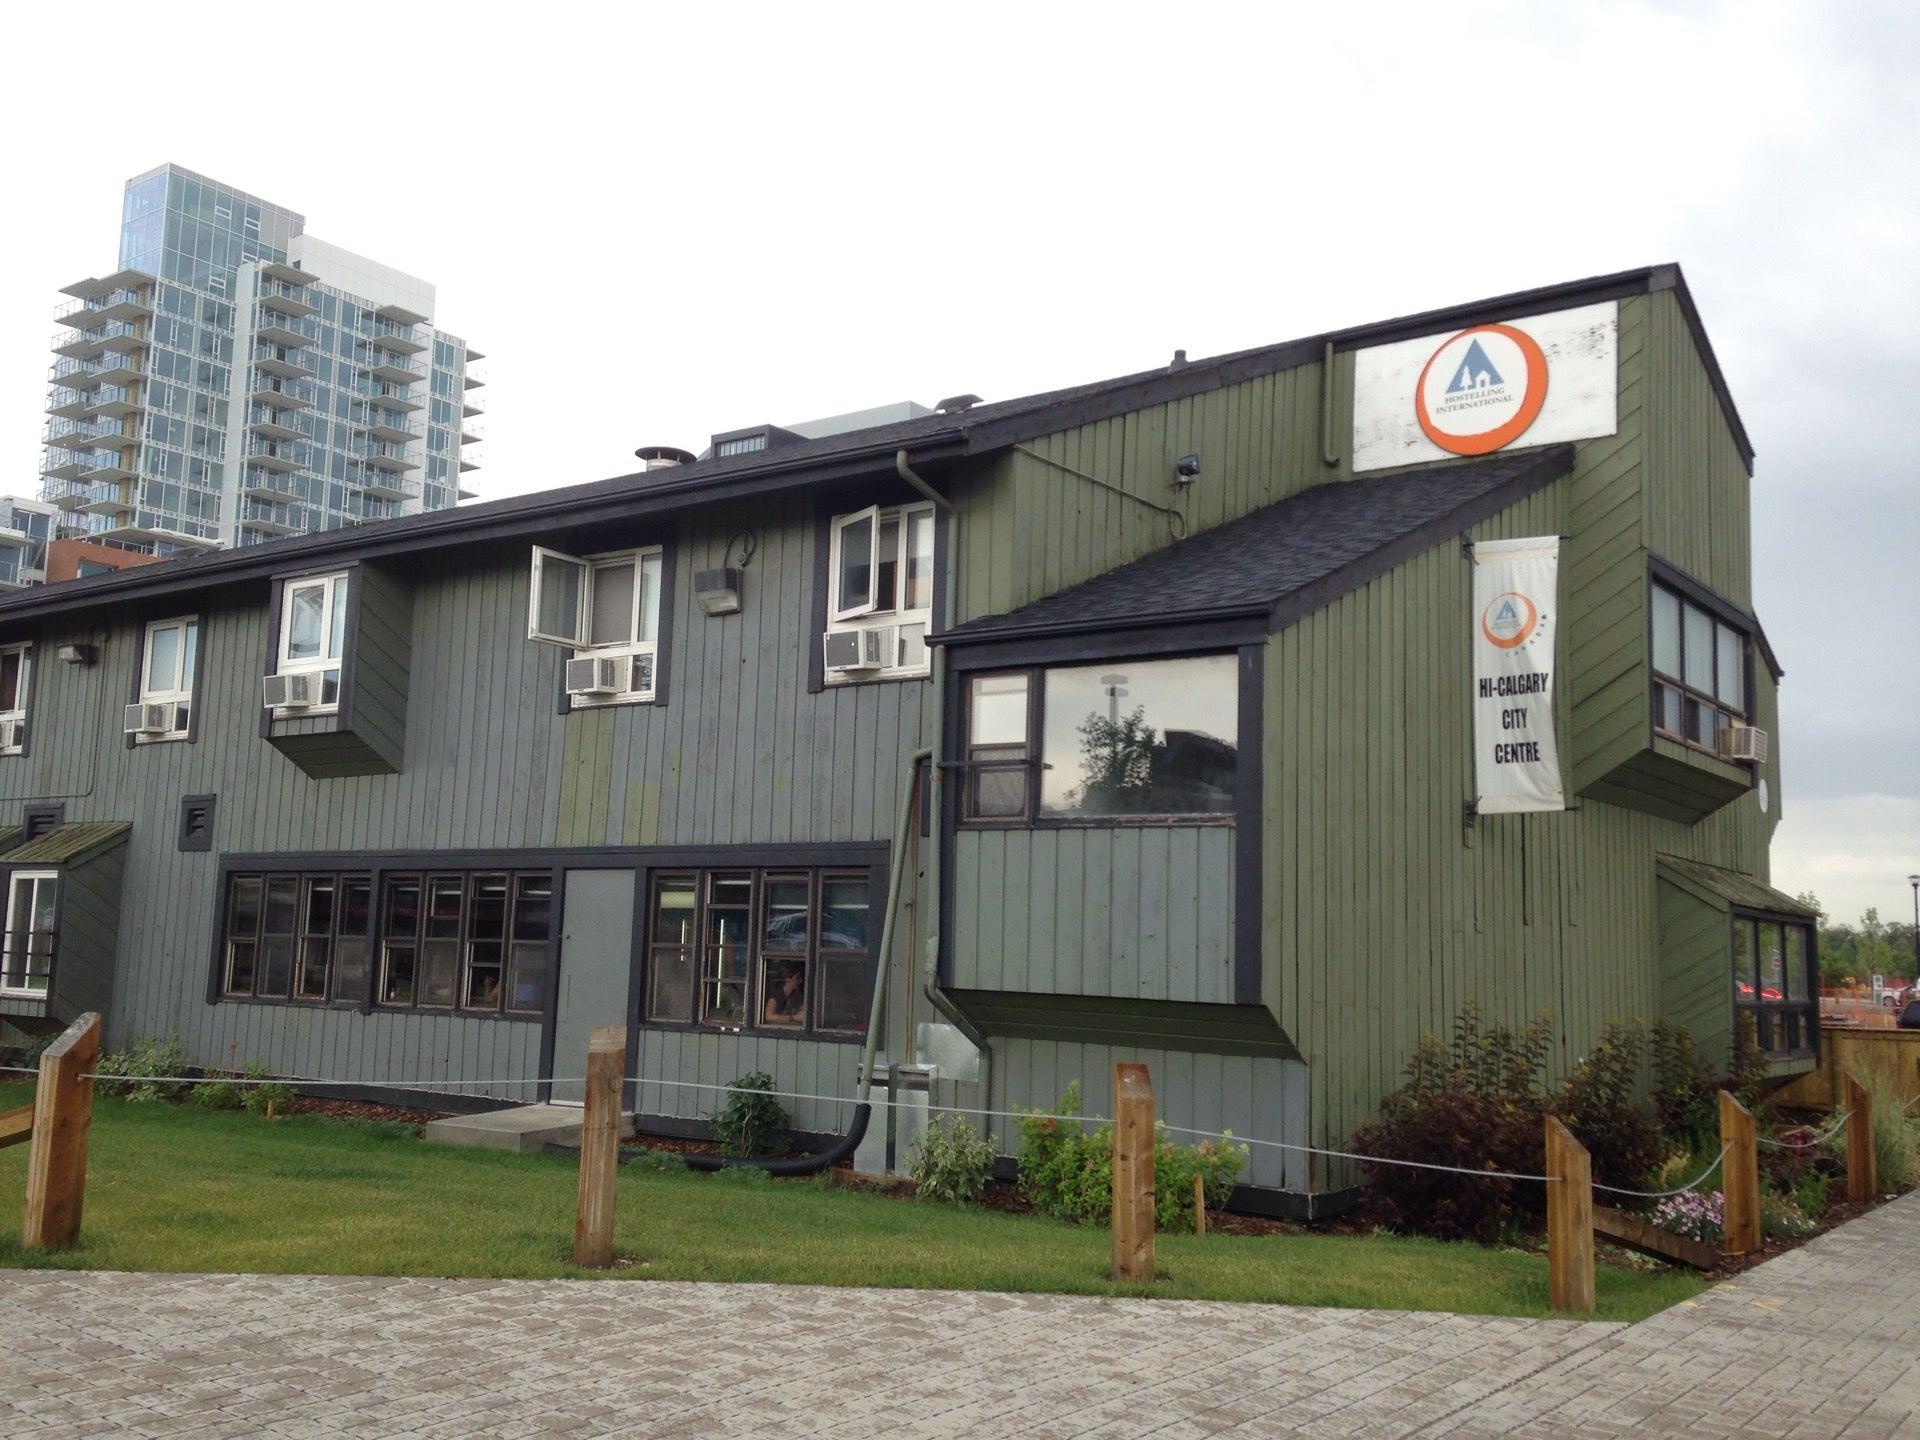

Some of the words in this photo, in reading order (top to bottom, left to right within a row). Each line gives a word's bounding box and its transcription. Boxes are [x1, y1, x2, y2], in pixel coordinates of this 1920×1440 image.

[1436, 395, 1514, 414] INTERNATIONAL
[1445, 387, 1505, 404] HOSTELLING
[1479, 672, 1549, 698] HI-CALGARY
[1502, 707, 1528, 730] CITY
[1495, 741, 1541, 764] CENTRE
